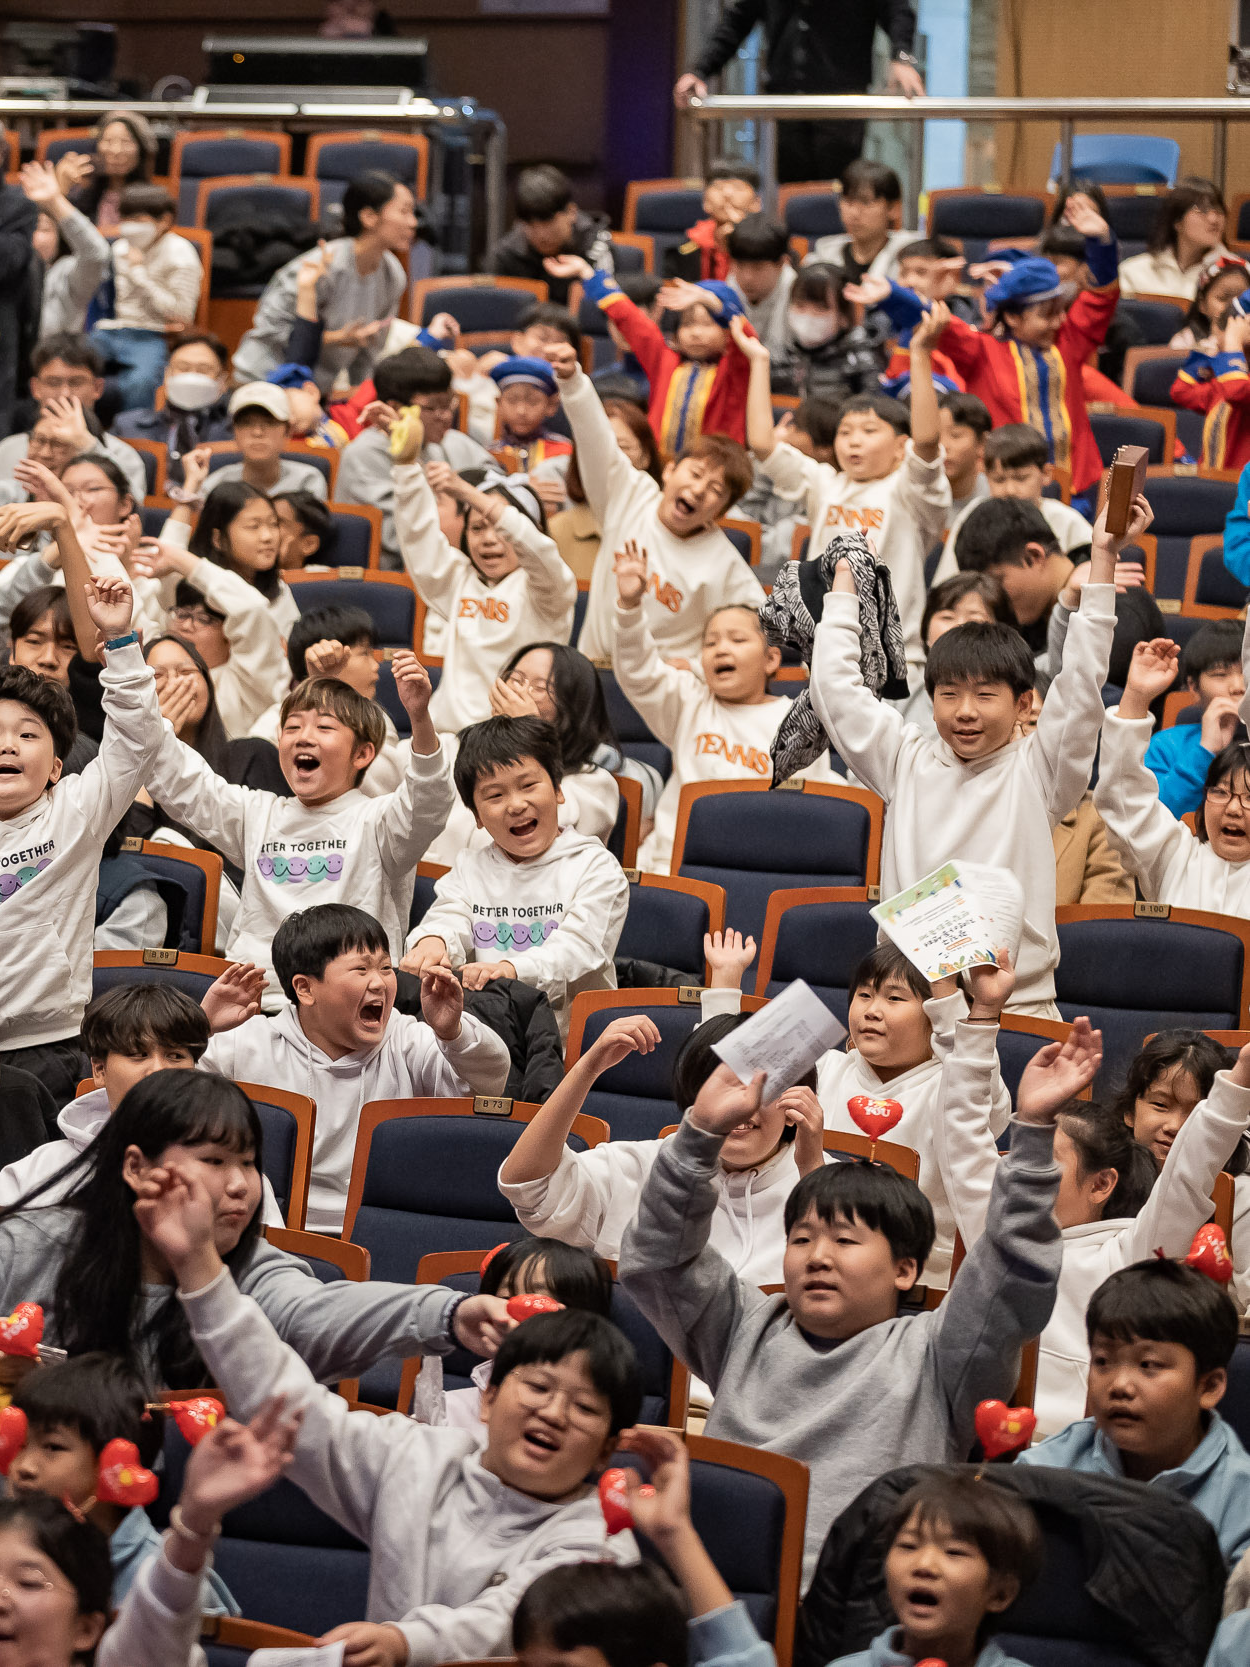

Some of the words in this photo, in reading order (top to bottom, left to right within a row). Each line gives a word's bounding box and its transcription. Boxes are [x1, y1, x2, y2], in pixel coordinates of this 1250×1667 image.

[695, 733, 770, 775] TENNIS
[512, 903, 564, 918] TOGETHER
[1150, 904, 1164, 913] 100
[483, 1099, 489, 1108] B
[492, 1100, 503, 1109] 73
[864, 1105, 891, 1118] YOU
